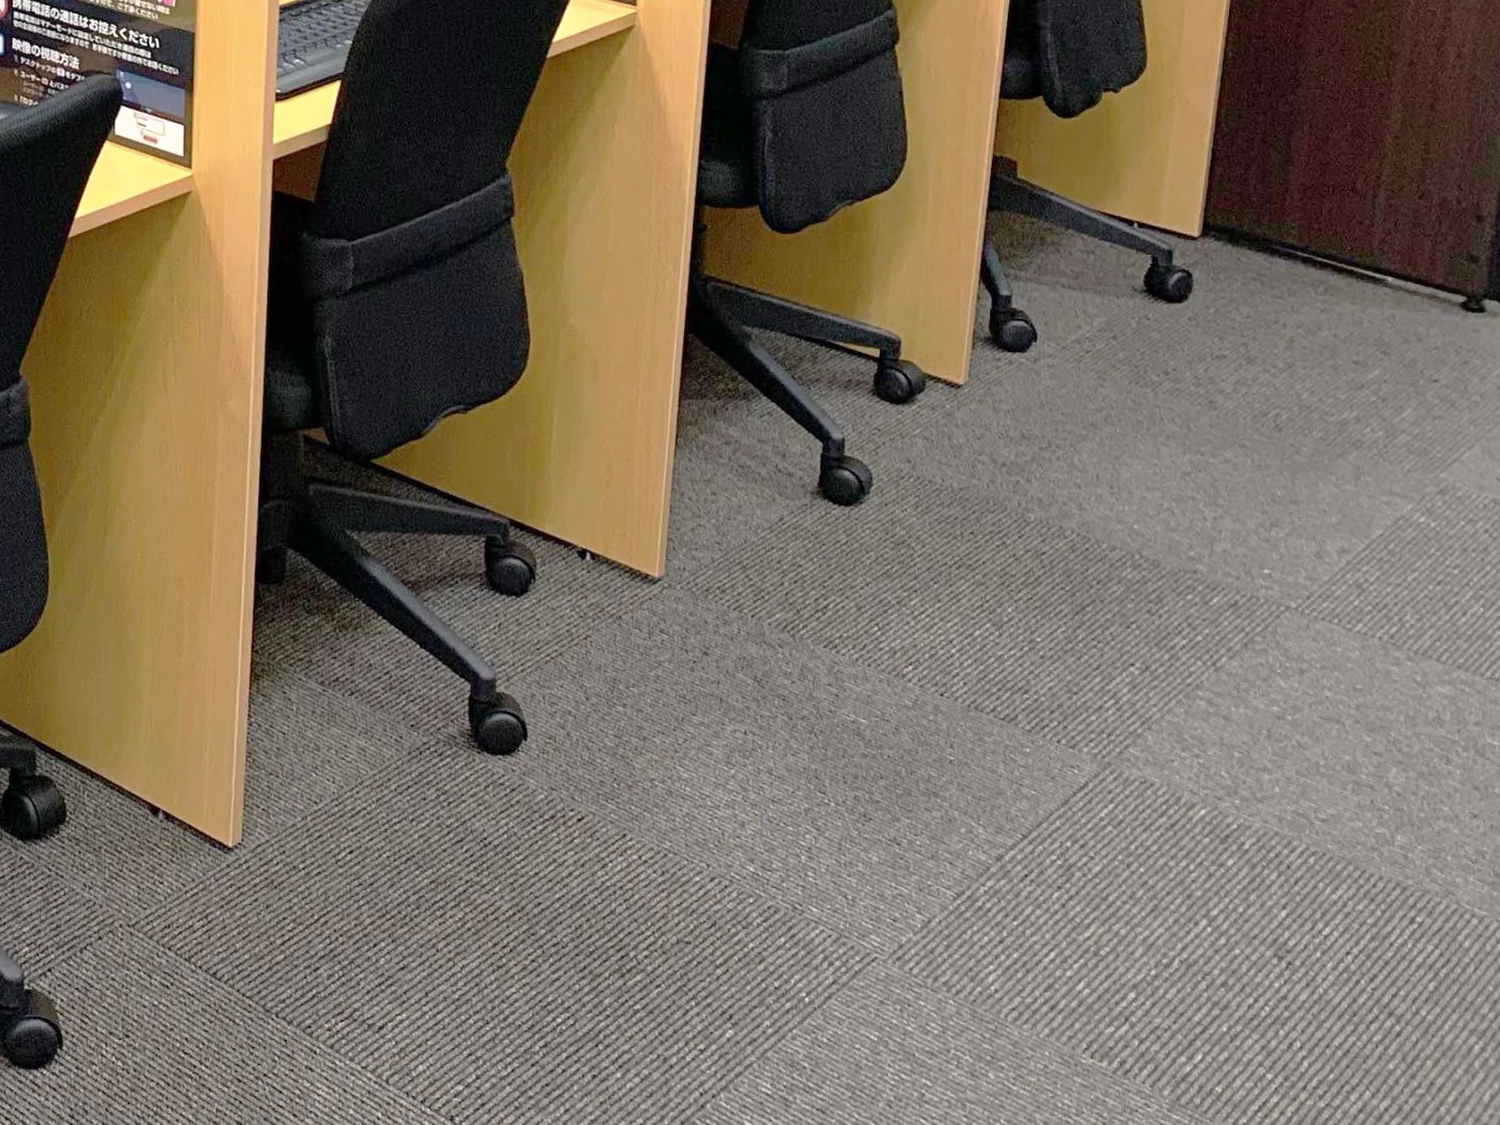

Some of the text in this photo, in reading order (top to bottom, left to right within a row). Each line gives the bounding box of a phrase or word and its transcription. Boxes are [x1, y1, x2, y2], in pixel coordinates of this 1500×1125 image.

[11, 38, 80, 70] 映像の視聴方法
